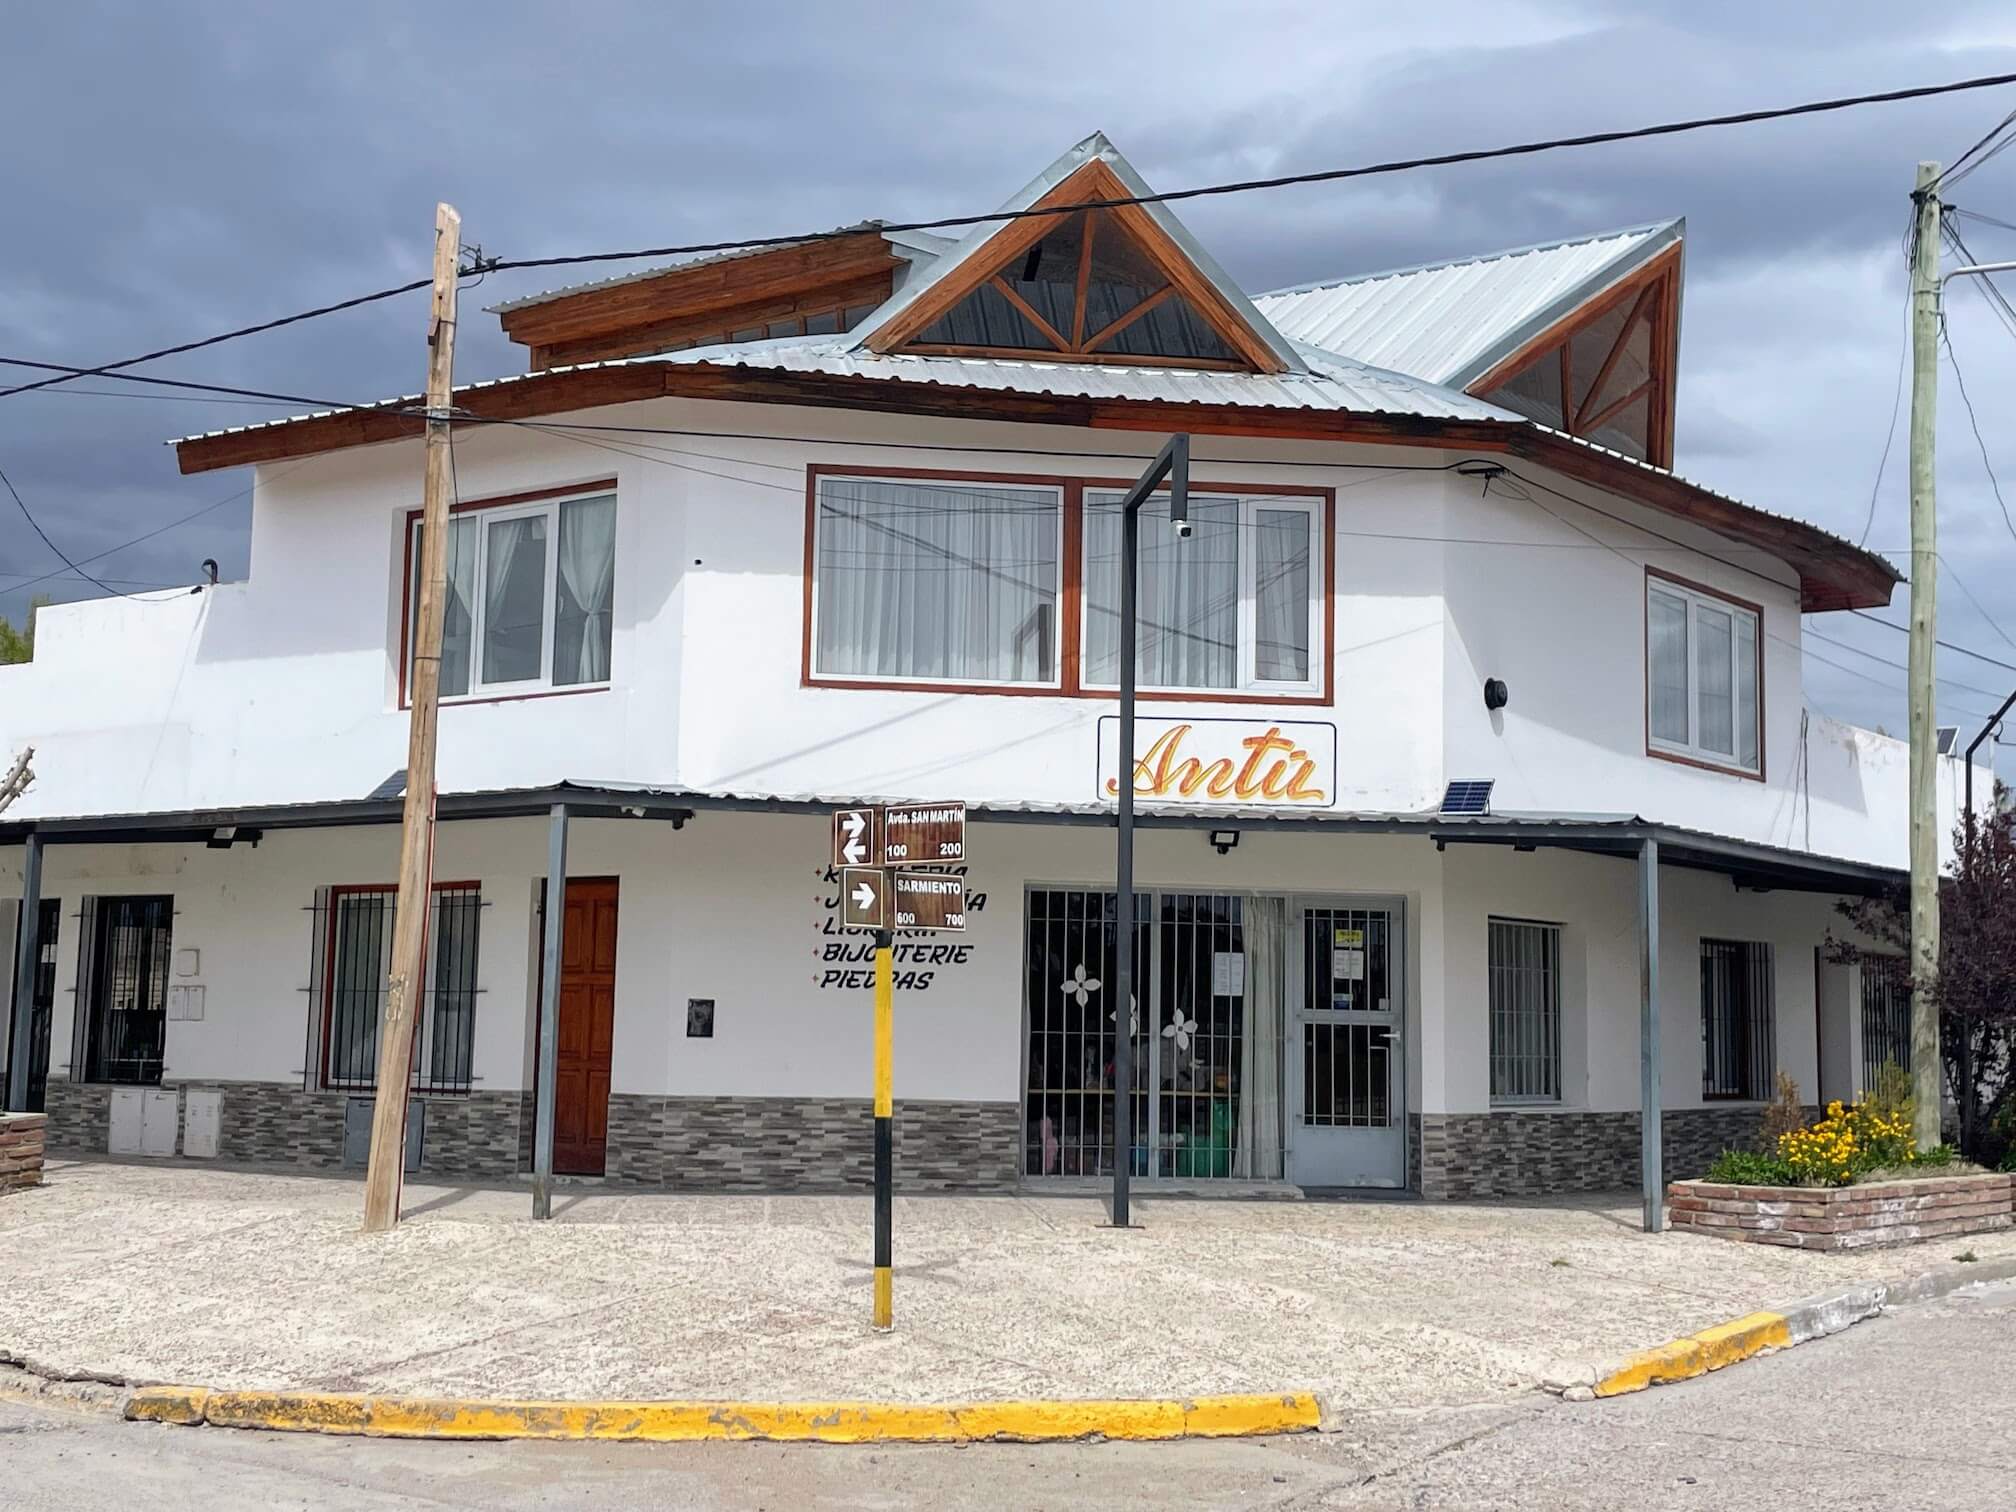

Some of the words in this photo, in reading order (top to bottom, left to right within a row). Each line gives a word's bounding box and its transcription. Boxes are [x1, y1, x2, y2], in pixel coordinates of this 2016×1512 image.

[1105, 724, 1325, 800] Antú
[888, 811, 911, 825] Avda.
[911, 810, 929, 824] SAN
[887, 844, 907, 857] 100
[940, 842, 961, 855] 200
[897, 879, 961, 895] SARMIENTO
[897, 911, 916, 924] 600
[945, 913, 964, 926] 700
